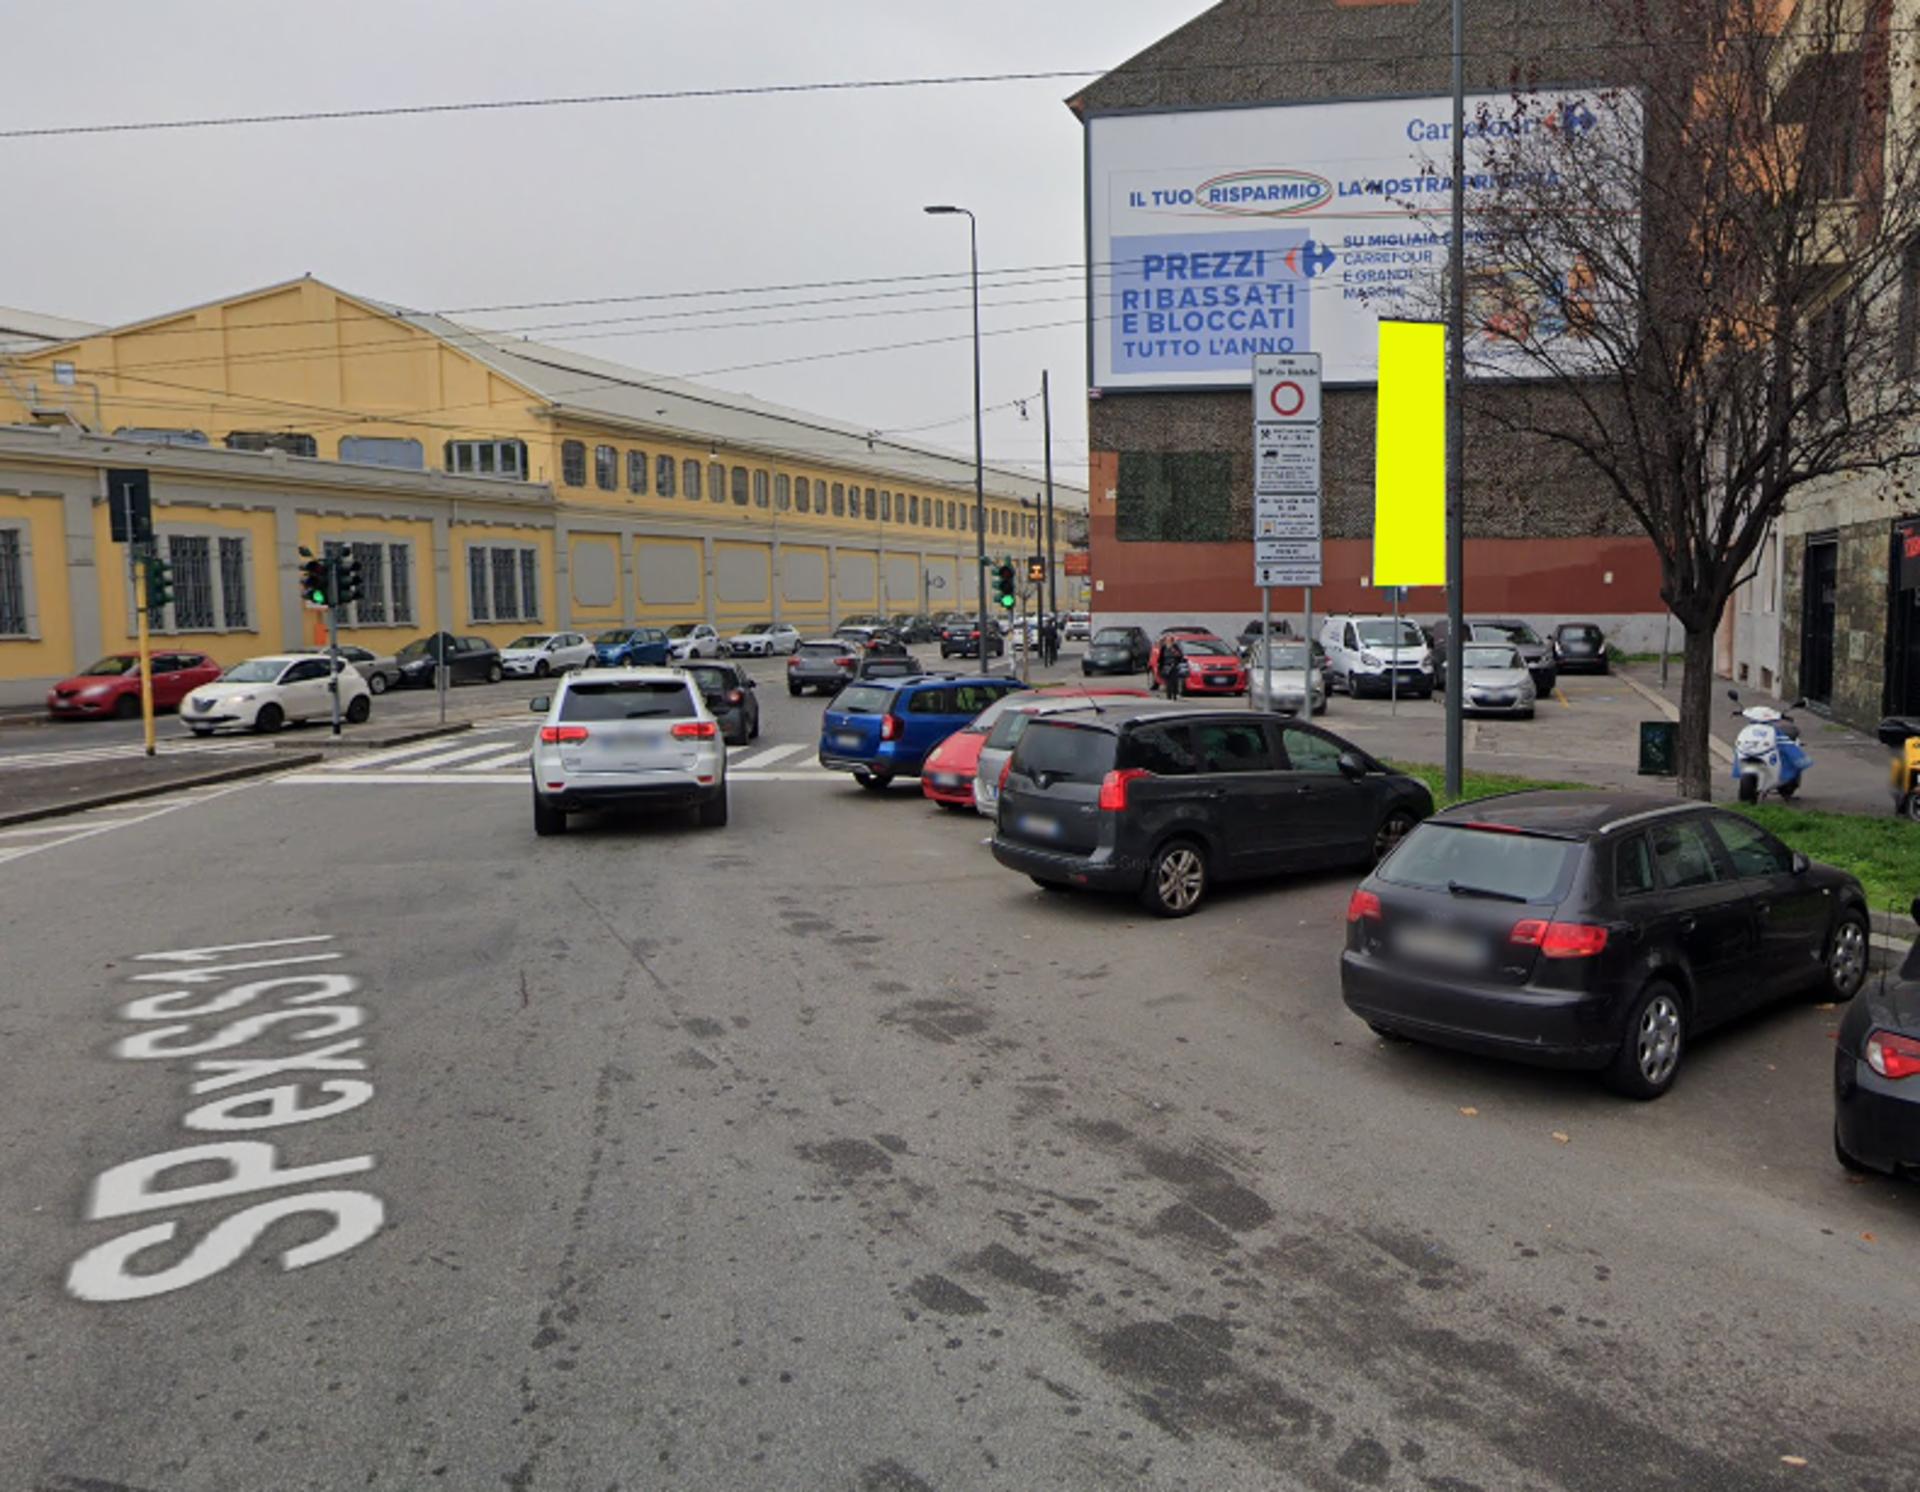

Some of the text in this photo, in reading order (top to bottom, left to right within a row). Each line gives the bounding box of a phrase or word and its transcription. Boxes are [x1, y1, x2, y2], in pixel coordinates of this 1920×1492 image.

[1407, 117, 1535, 142] Careour
[1130, 191, 1146, 207] IL
[1152, 189, 1194, 206] TUO
[1209, 183, 1321, 203] RISPARMIO
[1338, 180, 1362, 197] LA
[1343, 234, 1364, 248] SU
[1368, 232, 1438, 247] MIGLIAIA
[1142, 250, 1265, 281] PREZZI
[1343, 250, 1432, 265] CARREFOUR
[1343, 268, 1413, 283] E GRANDI
[1122, 283, 1294, 310] RIBASSATI
[1122, 308, 1294, 334] E BLOCCATI
[1123, 336, 1294, 358] TUTTO L'ANNO
